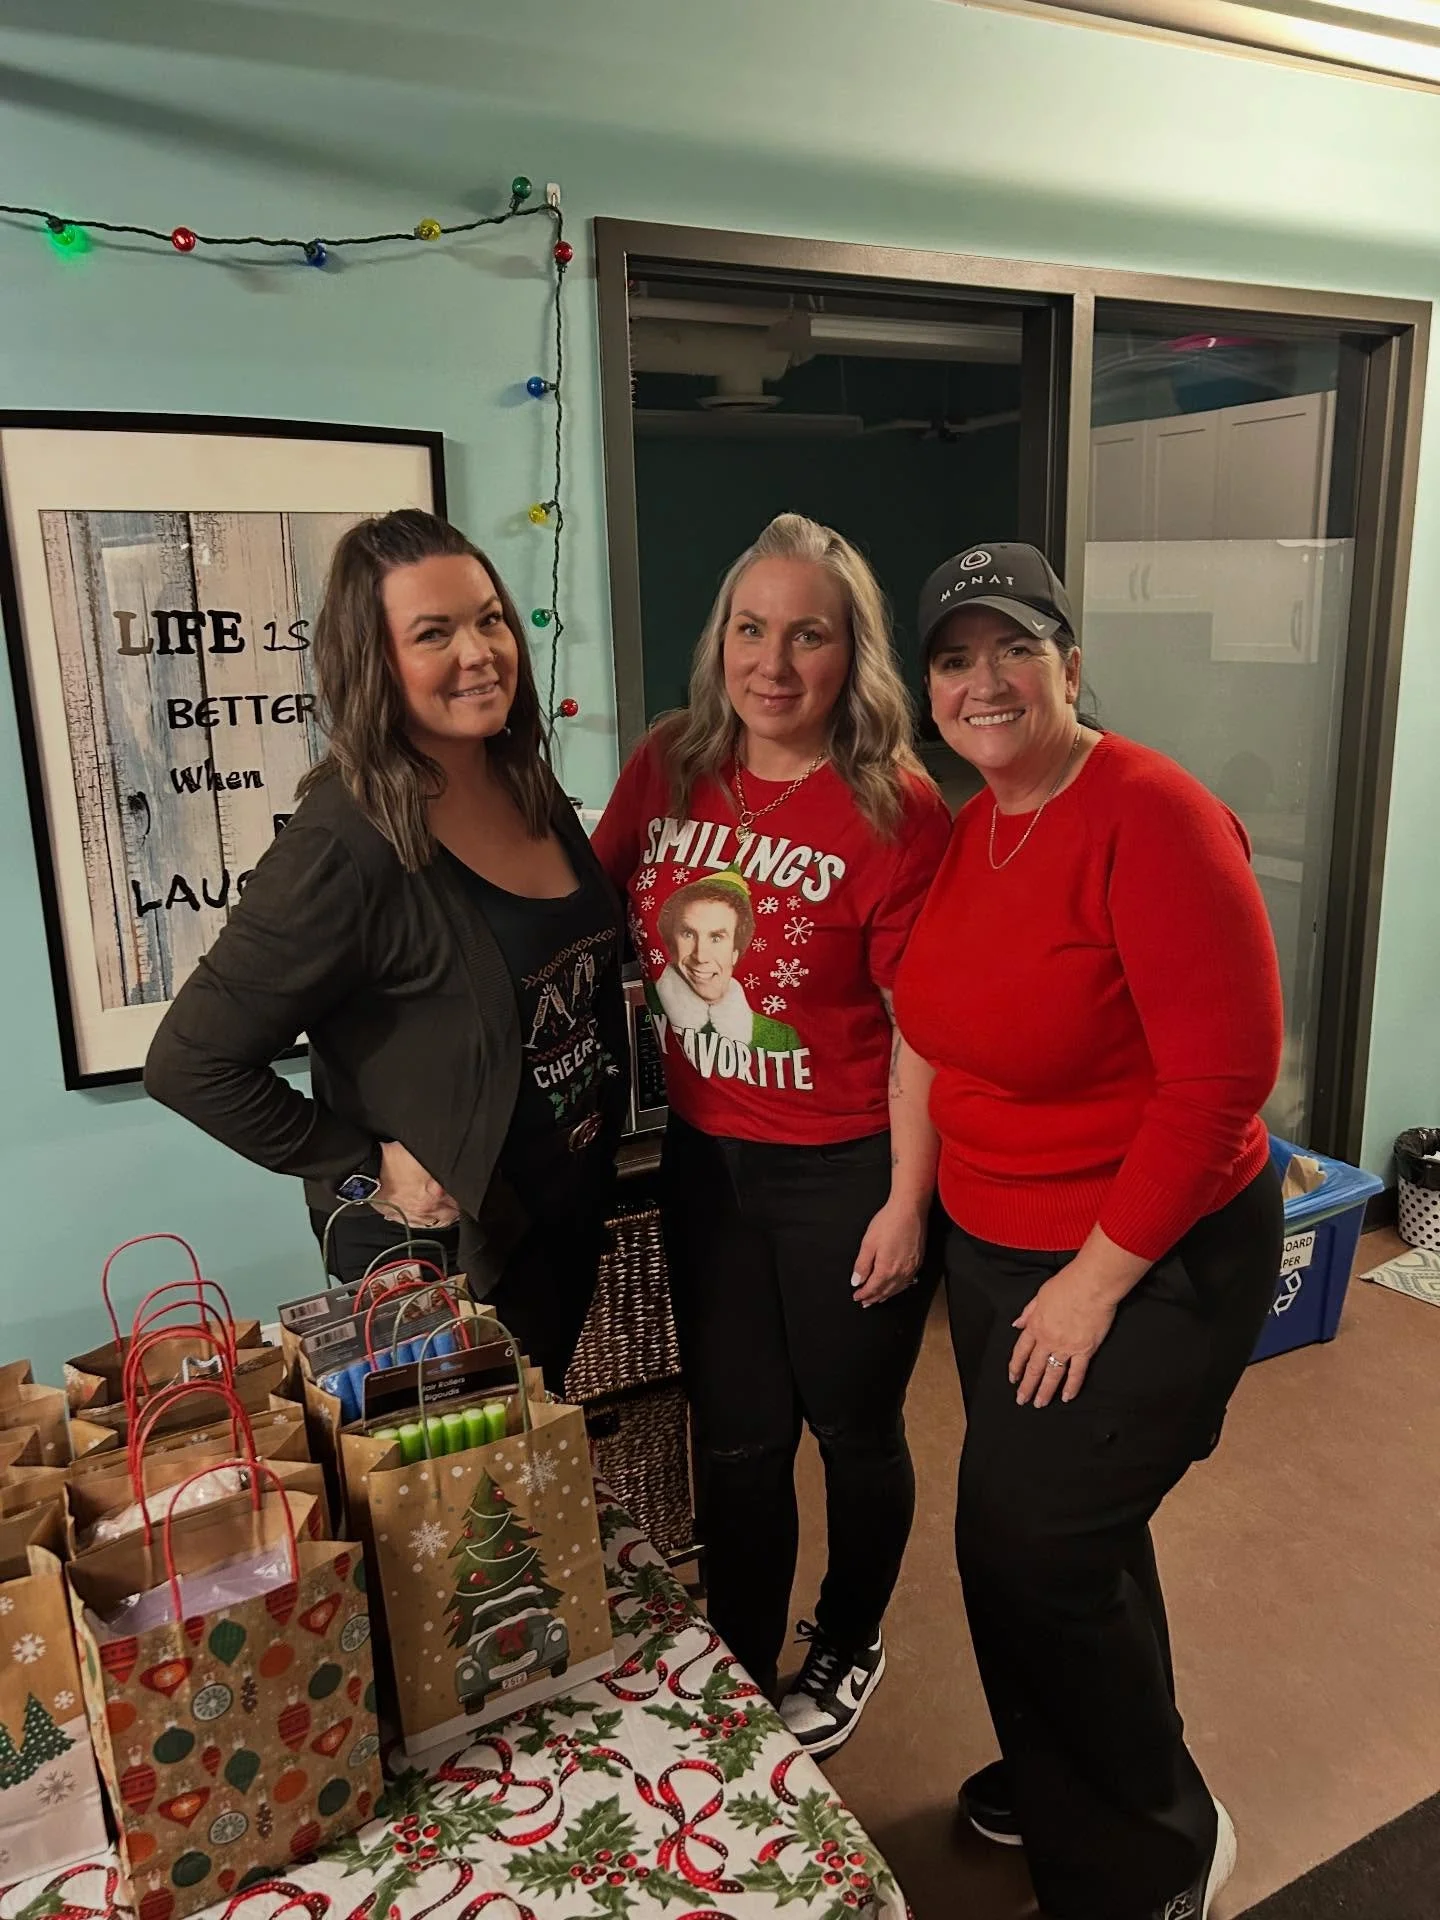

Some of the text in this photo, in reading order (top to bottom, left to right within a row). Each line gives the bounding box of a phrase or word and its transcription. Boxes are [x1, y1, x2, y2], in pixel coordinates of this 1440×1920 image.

[940, 575, 1014, 602] MONAT
[113, 609, 245, 656] LIFE
[167, 693, 317, 730] BETTER
[170, 756, 264, 795] When
[644, 817, 845, 902] SMILING'S
